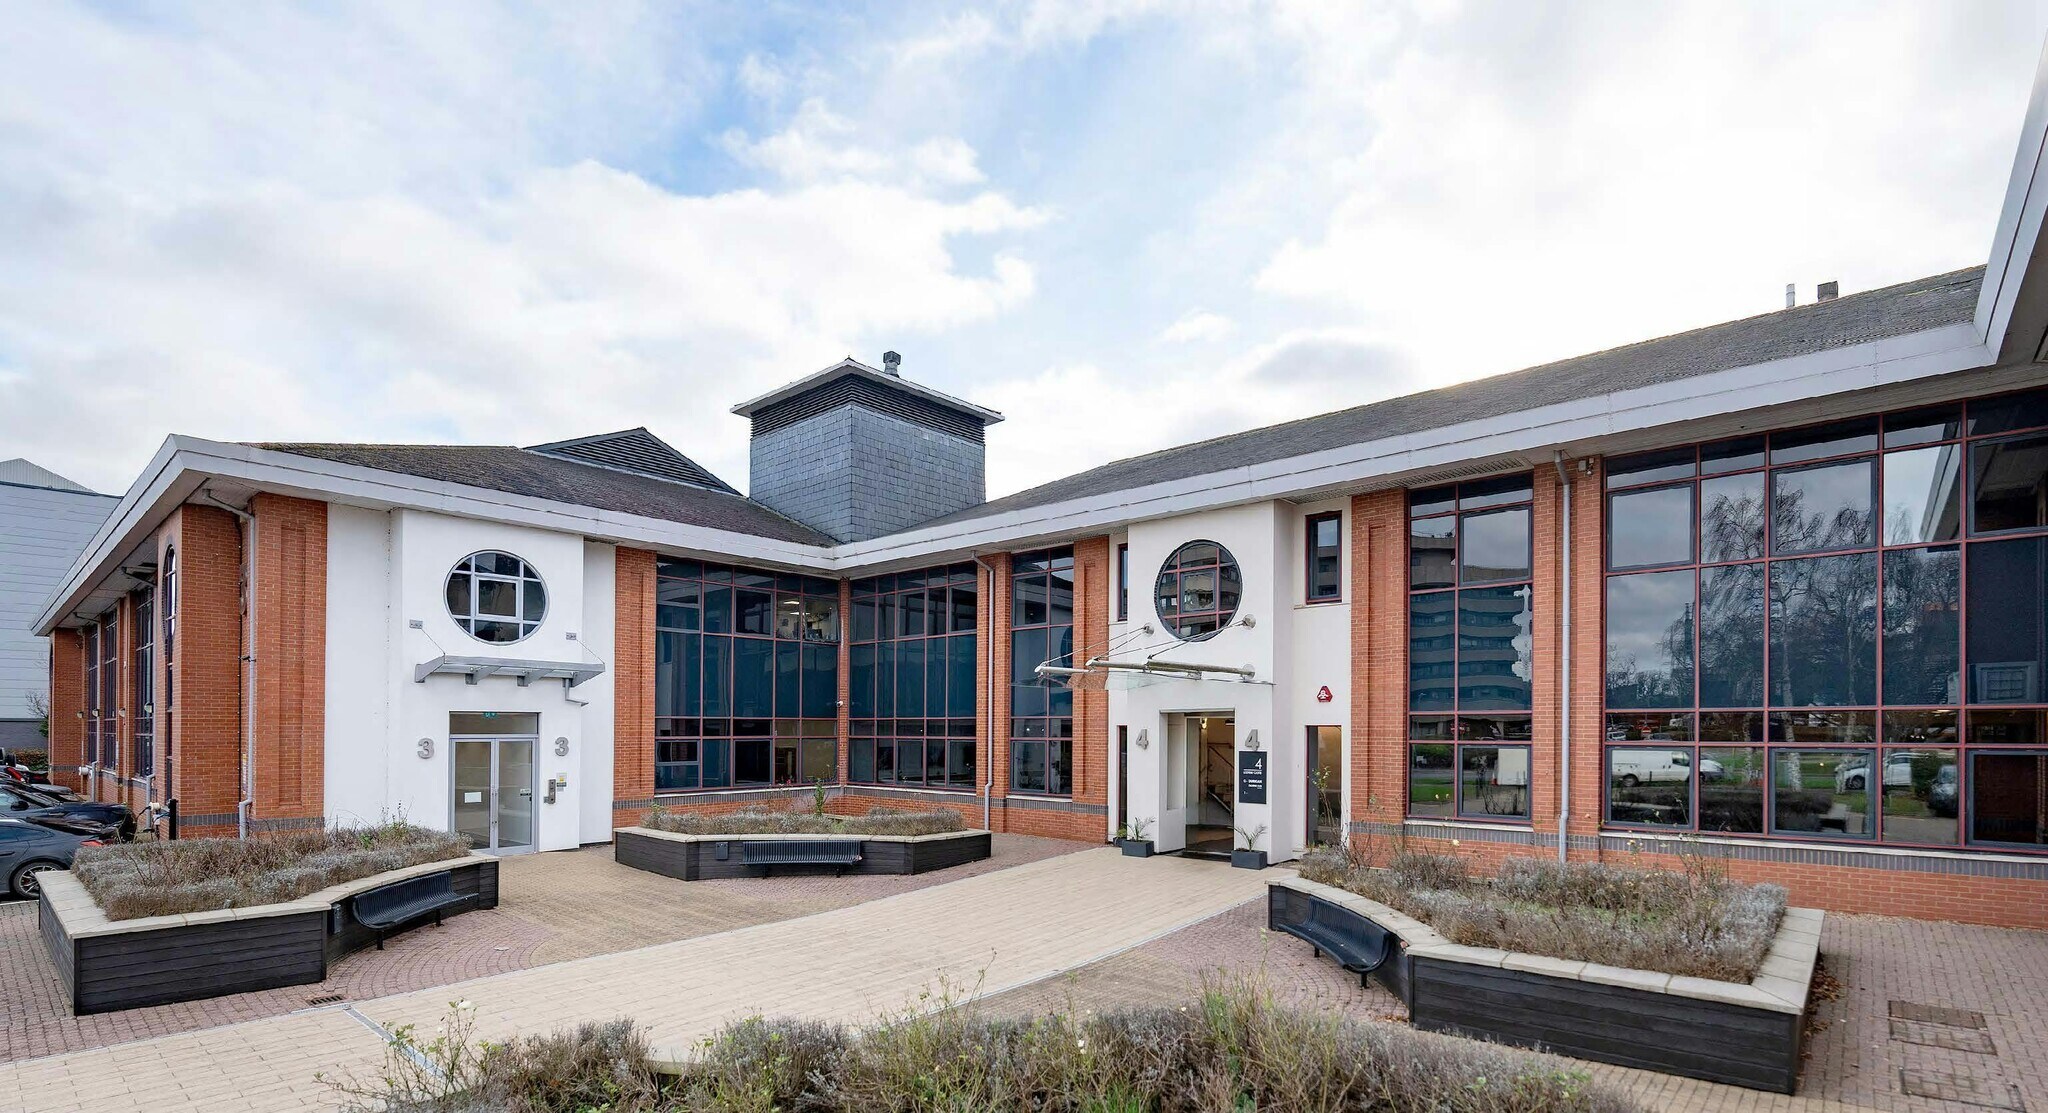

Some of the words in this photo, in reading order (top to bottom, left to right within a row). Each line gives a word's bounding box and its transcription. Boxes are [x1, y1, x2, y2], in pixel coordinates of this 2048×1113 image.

[417, 737, 435, 759] 3
[555, 737, 569, 757] 3
[1136, 729, 1149, 750] 4
[1245, 729, 1260, 751] 4
[1255, 758, 1262, 769] 4
